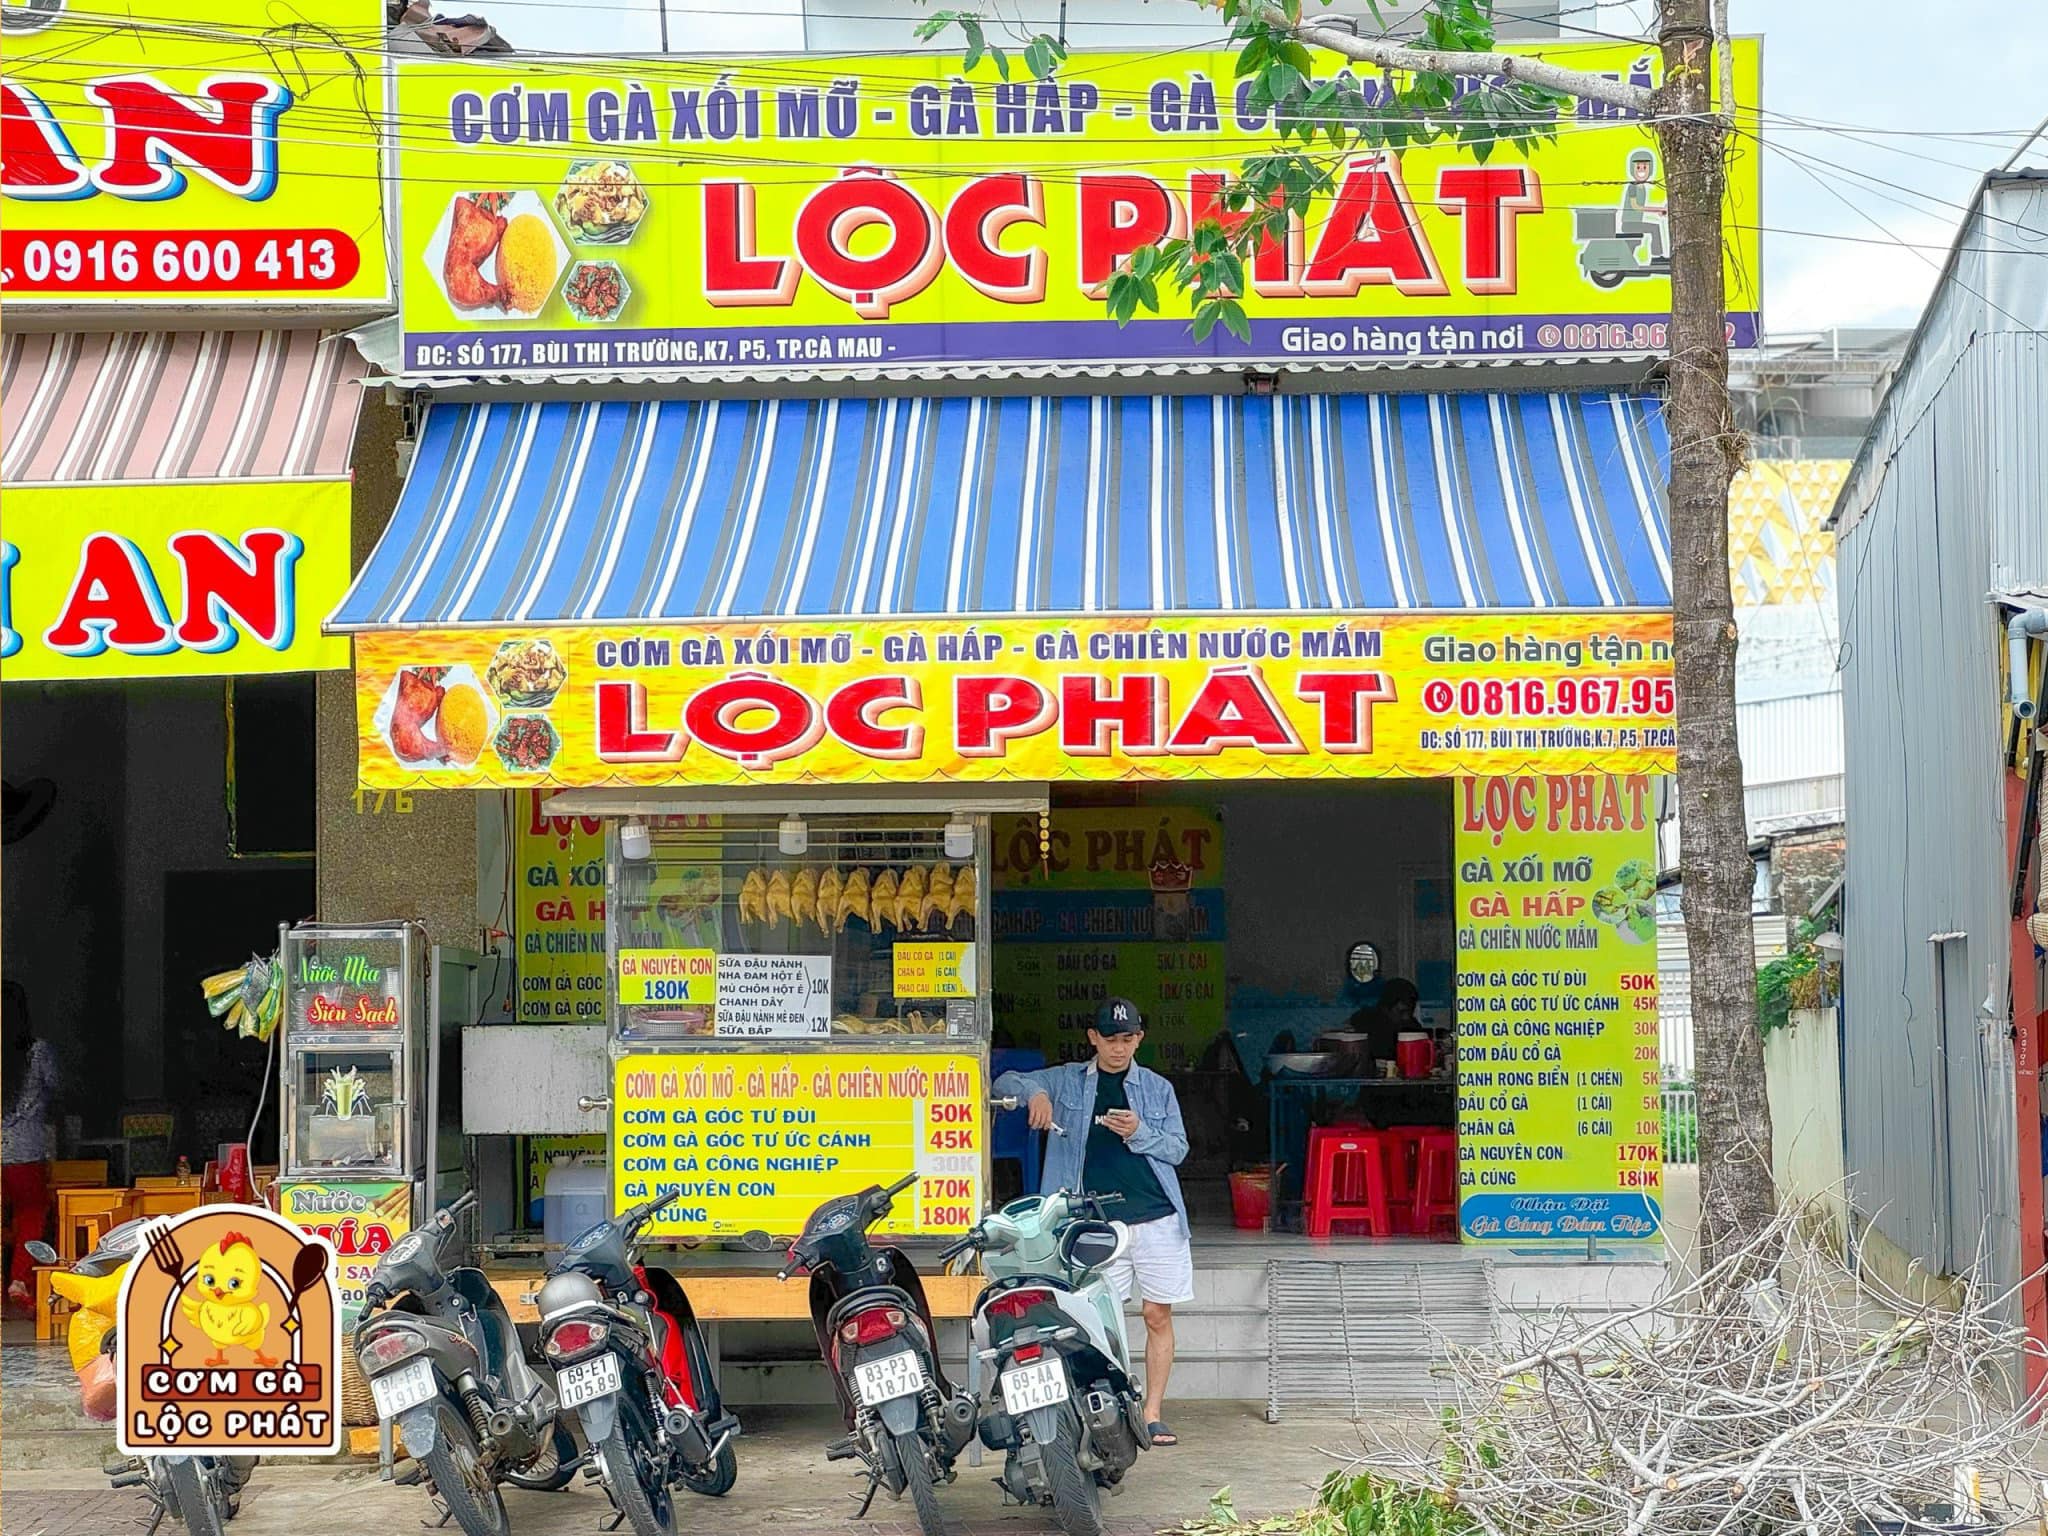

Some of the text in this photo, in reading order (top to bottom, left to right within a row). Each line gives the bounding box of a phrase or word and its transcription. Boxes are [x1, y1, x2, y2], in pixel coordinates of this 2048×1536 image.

[451, 85, 571, 144] CƠM
[587, 81, 658, 142] GÀ
[671, 73, 760, 140] XỐI
[778, 79, 859, 139] MỠ
[909, 78, 980, 137] GÀ
[994, 67, 1099, 134] HẤP
[1150, 72, 1220, 133] GÀ
[702, 151, 1544, 320] LỘC PHÁT
[23, 238, 338, 282] 0916 600 413
[417, 347, 452, 366] ĐC:
[458, 339, 486, 366] SỐ
[491, 344, 527, 368] 177,
[533, 341, 569, 364] BÙI
[574, 342, 609, 368] THỊ
[740, 341, 771, 363] P5,
[777, 335, 832, 361] TP.CÀ
[838, 338, 884, 358] MAU
[1281, 324, 1525, 357] Giao hàng tận nơi
[42, 527, 304, 658] AN
[597, 624, 1381, 668] CƠM GÀ XỐI MỠ GÀ HẤP GÀ CHIÊN NƯỚC MẮM
[1424, 634, 1644, 670] Giao hàng tận
[596, 663, 1398, 771] LỘC PHÁT
[1444, 725, 1461, 750] SỐ
[1464, 730, 1487, 752] 177,
[1490, 727, 1513, 749] BÙI
[1515, 728, 1537, 753] THỊ
[1619, 729, 1641, 751] P.5,
[1461, 853, 1593, 883] GÀ XỐI MỠ
[1469, 888, 1586, 918] GÀ HẤP
[1459, 920, 1598, 950] GÀ CHIÊN NƯỚC MẮM
[622, 955, 712, 976] GÀ NGUYÊN CON
[718, 957, 741, 968] SỮA
[744, 957, 768, 970] ĐẬU
[812, 979, 829, 994] 10K
[1457, 968, 1656, 990] CƠM GÀ GÓC TƯ ĐÙI 50K
[643, 981, 690, 1000] 180K
[719, 998, 758, 1008] CHANH
[1457, 993, 1657, 1012] CƠM GÀ GÓC TƯ ỨC CÁNH 45K
[719, 1025, 744, 1035] SỮA
[811, 1017, 829, 1033] 12K
[1458, 1019, 1658, 1039] CƠM GÀ CÔNG NGHIỆP 30K
[1458, 1040, 1658, 1061] CƠM ĐẦU CỔ GÀ 20K
[1458, 1065, 1659, 1086] CANH RONG BIỂN 5K
[623, 1103, 973, 1125] CƠM GÀ GÓC TƯ ĐÙI 50K
[623, 1128, 973, 1149] CƠM GÀ GÓC TƯ ỨC CÁNH 45K
[1459, 1141, 1658, 1161] GÀ NGUYÊN CON 170K
[623, 1153, 839, 1175] CƠM GÀ CÔNG NGHIỆP
[1459, 1167, 1659, 1187] GÀ CÚNG 180K
[624, 1181, 648, 1197] GÀ
[737, 1182, 775, 1197] CON
[922, 1179, 972, 1199] 170K
[290, 1189, 367, 1213] Nước
[656, 1203, 708, 1222] CÚNG
[922, 1206, 972, 1226] 180K
[567, 1359, 608, 1386] 69-E1
[865, 1358, 908, 1383] 83-P3
[1012, 1364, 1055, 1388] 69-AA
[565, 1373, 618, 1405] 105.89
[1010, 1382, 1064, 1410] 114.02
